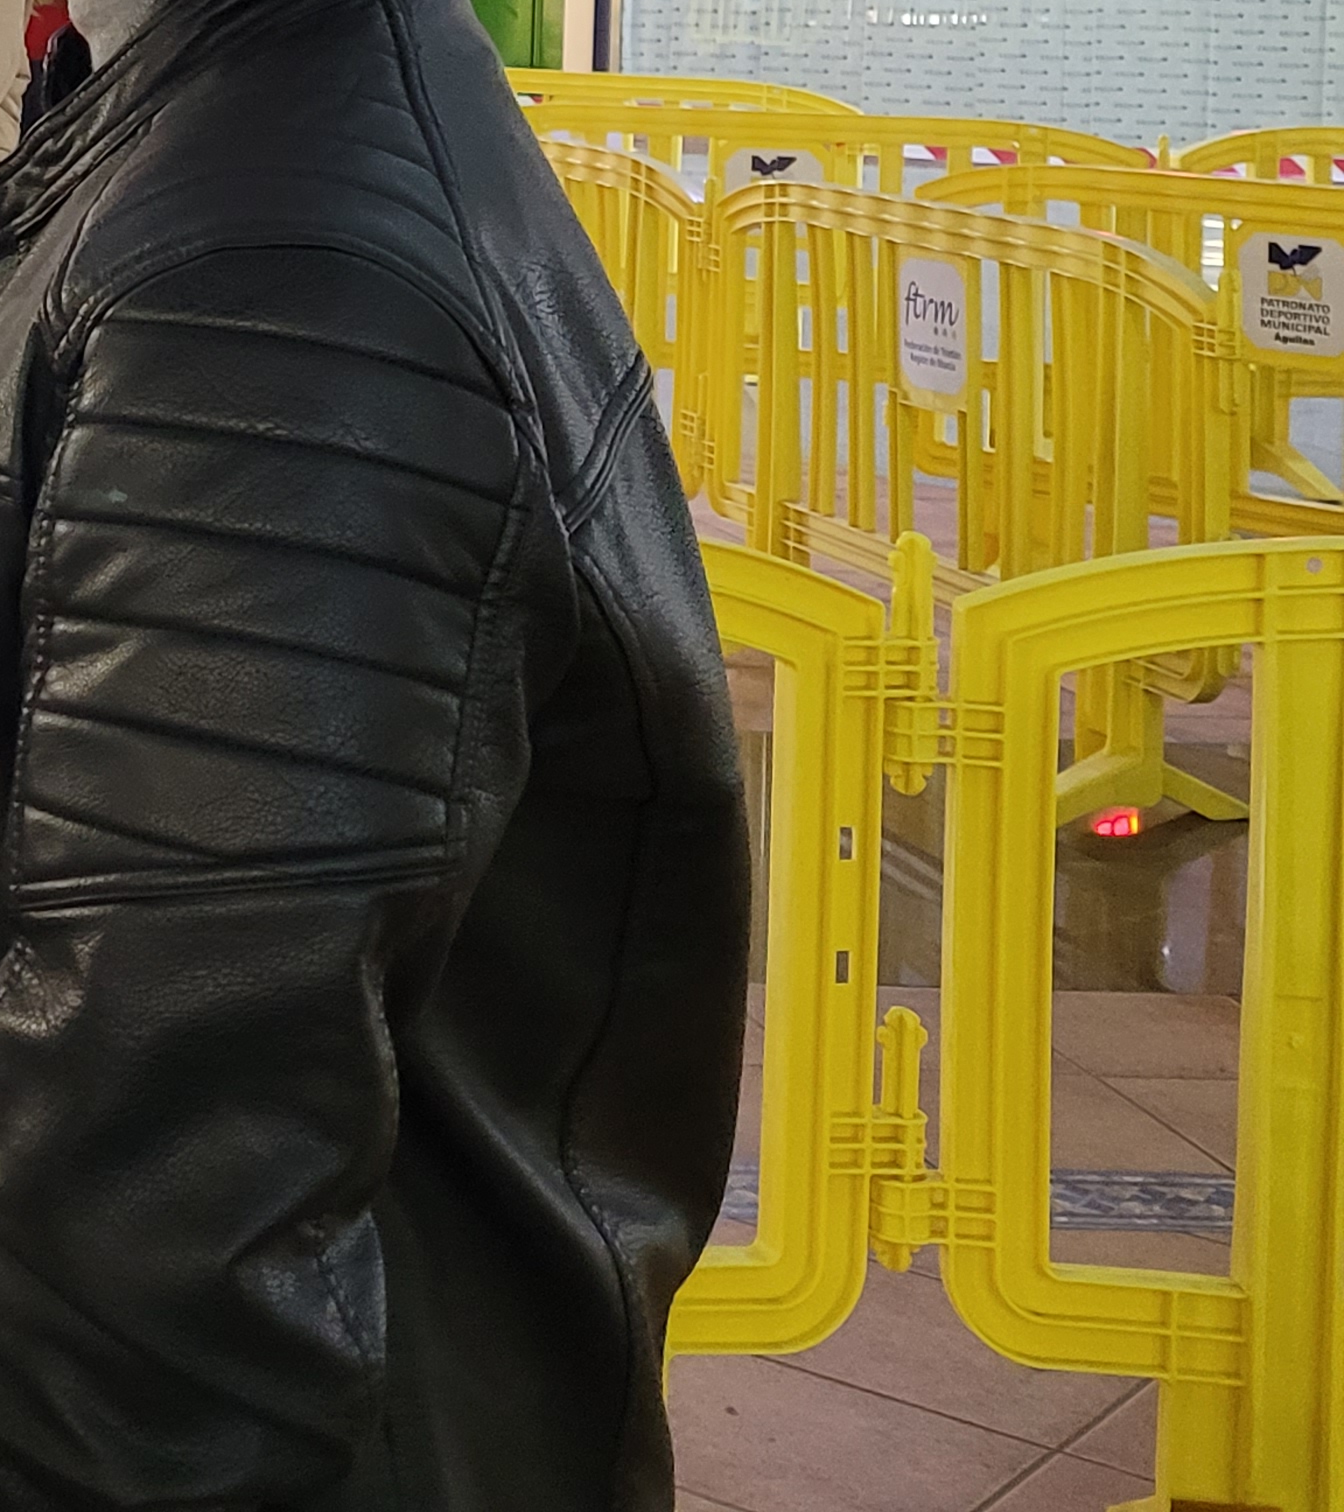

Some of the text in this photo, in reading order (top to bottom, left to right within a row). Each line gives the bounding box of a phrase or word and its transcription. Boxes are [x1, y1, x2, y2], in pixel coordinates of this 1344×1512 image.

[1261, 297, 1331, 314] PATRONATO
[1260, 308, 1331, 325] DEPORTIVO
[1260, 319, 1331, 336] MUNICIPAL
